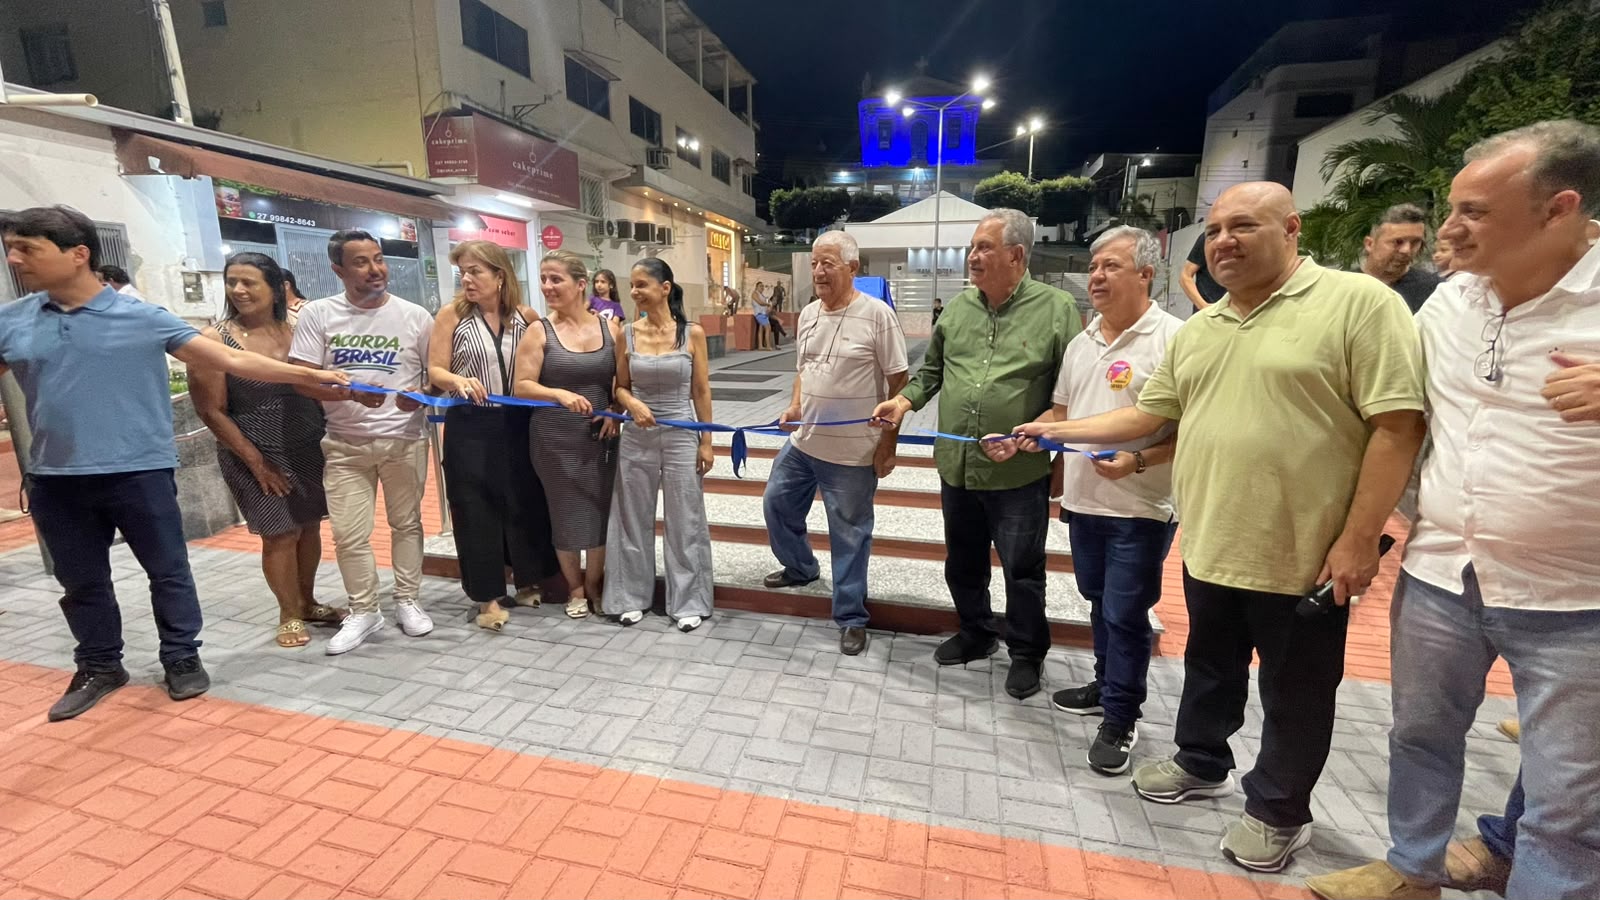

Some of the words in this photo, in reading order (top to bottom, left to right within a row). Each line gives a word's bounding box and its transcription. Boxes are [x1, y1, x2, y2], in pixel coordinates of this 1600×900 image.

[431, 137, 468, 146] cakeprime
[512, 160, 553, 179] cakeprime
[256, 212, 267, 220] 27
[269, 214, 316, 227] 99842-8643
[330, 348, 402, 367] BRASIL
